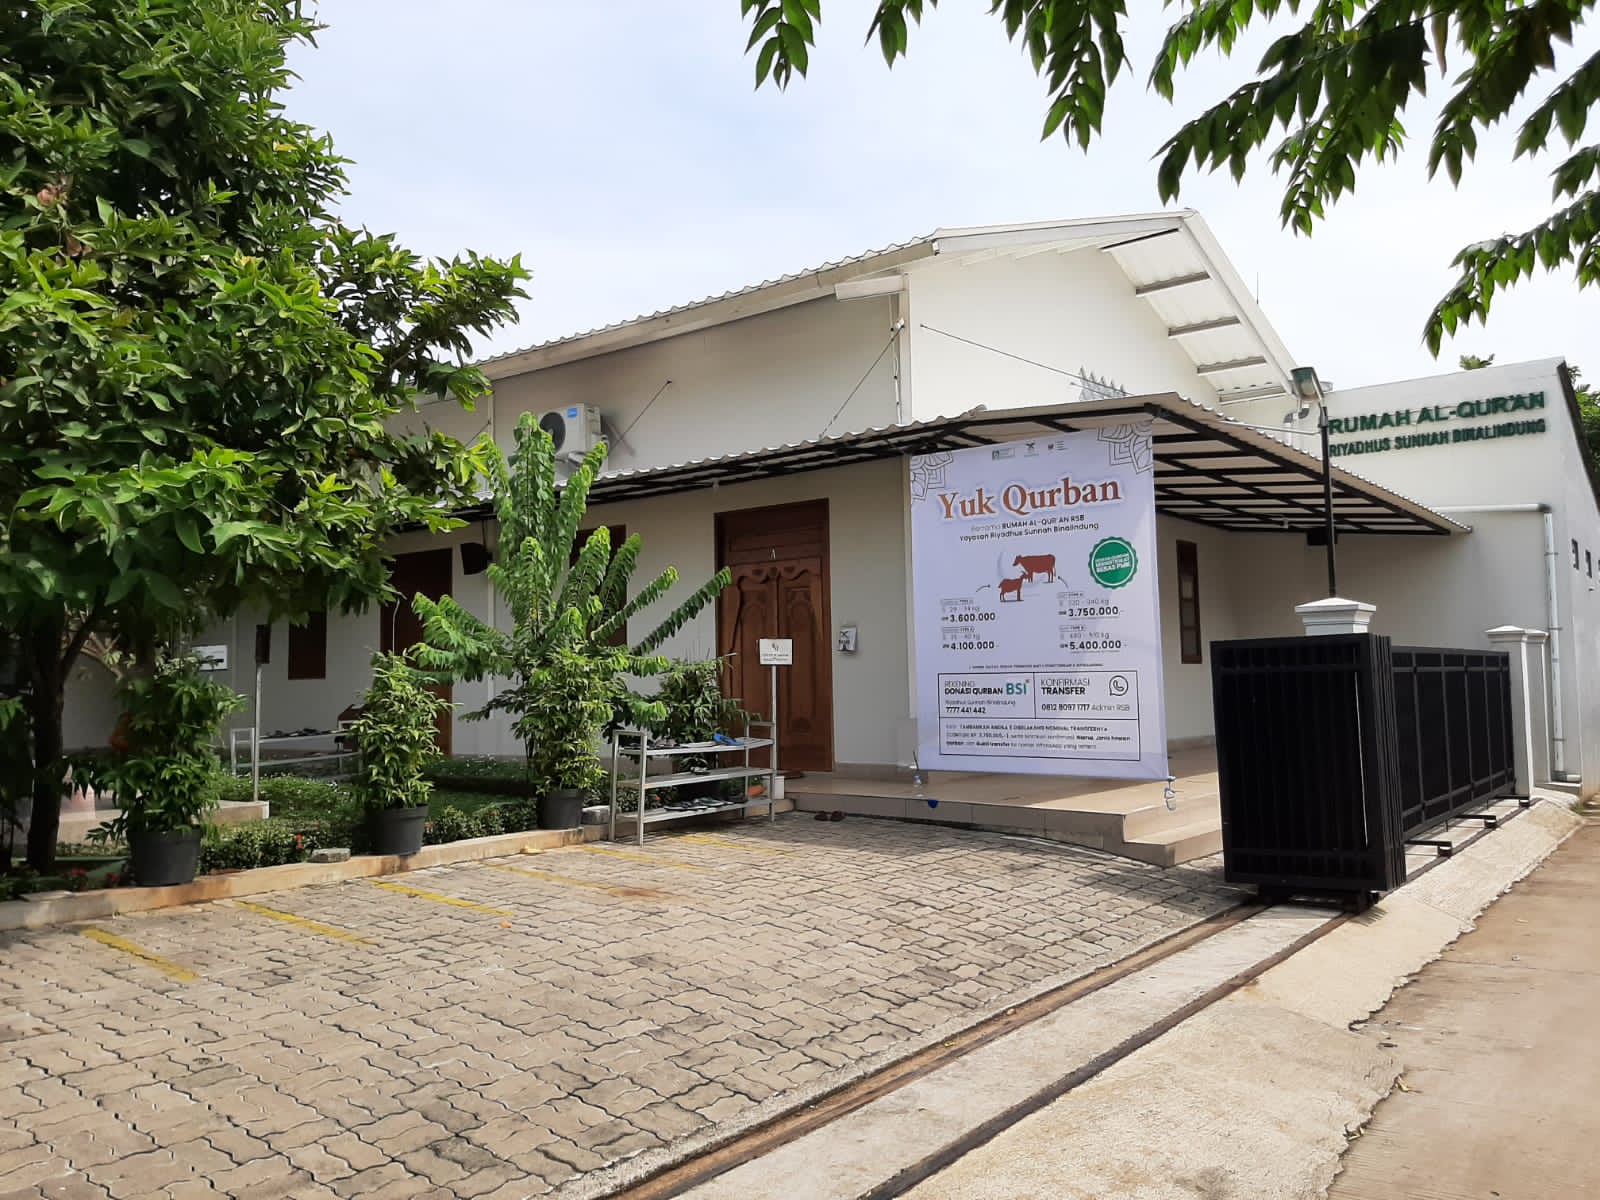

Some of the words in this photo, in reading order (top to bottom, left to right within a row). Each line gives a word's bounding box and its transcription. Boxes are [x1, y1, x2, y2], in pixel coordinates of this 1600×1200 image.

[1328, 409, 1411, 435] RUMAH
[1328, 437, 1391, 458] RIYADHUS
[1394, 431, 1449, 450] SUNNAH
[1453, 418, 1546, 443] BINALINDUNG
[938, 487, 996, 519] Yuk
[1002, 477, 1121, 516] Qurban
[1002, 519, 1028, 530] RUMAH
[960, 533, 989, 543] Yayasan
[1024, 527, 1053, 537] Sunnah
[1006, 682, 1027, 695] BSI
[1041, 678, 1090, 687] KONFIRMASI
[944, 687, 971, 695] DONASI
[972, 687, 1003, 696] QURBAN
[1041, 687, 1085, 695] TRANSFER
